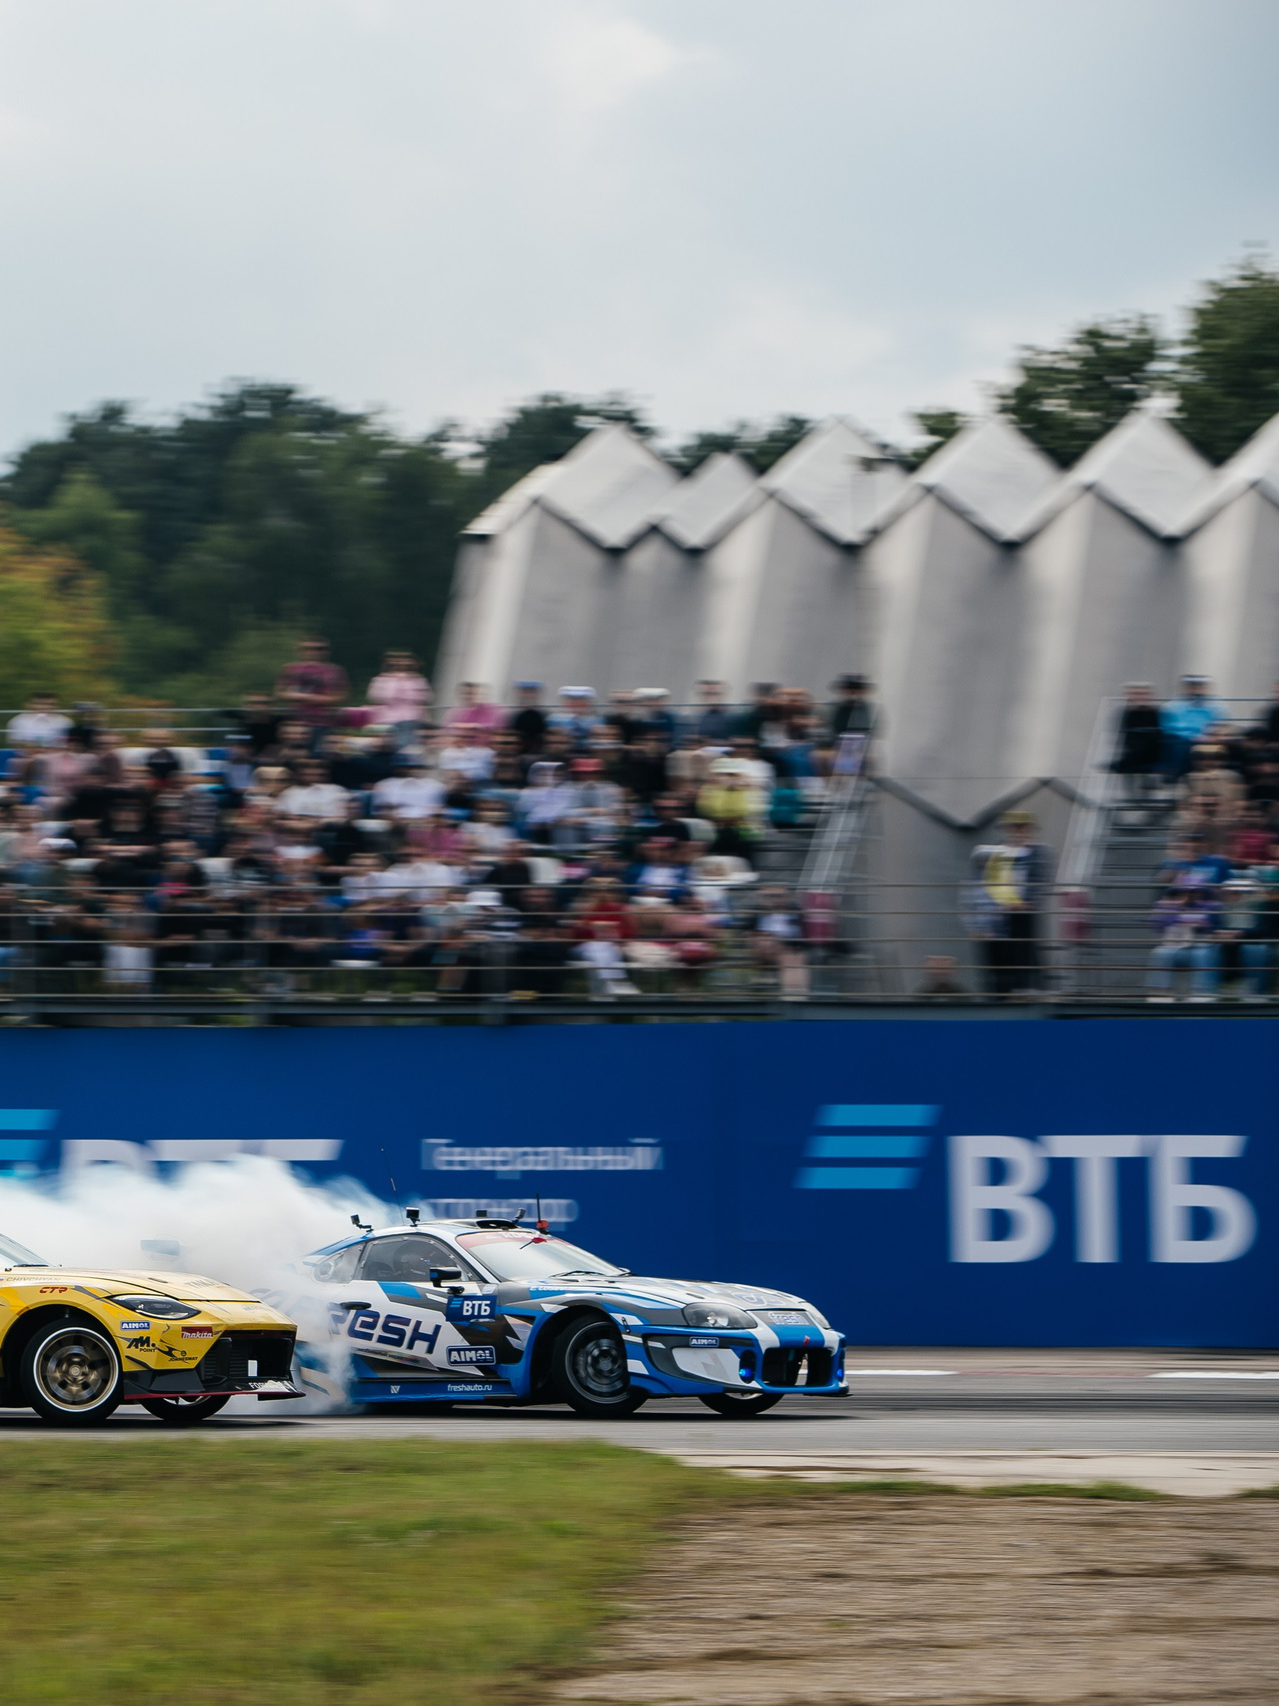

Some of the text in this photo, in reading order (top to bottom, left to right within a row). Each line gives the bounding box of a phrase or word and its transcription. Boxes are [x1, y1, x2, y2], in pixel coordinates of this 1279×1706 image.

[947, 1135, 1258, 1263] ВТБ
[462, 1300, 491, 1316] ВТБ
[182, 1331, 213, 1339] makita
[450, 1350, 494, 1363] AIMOL
[447, 1384, 492, 1392] freshauto.ru
